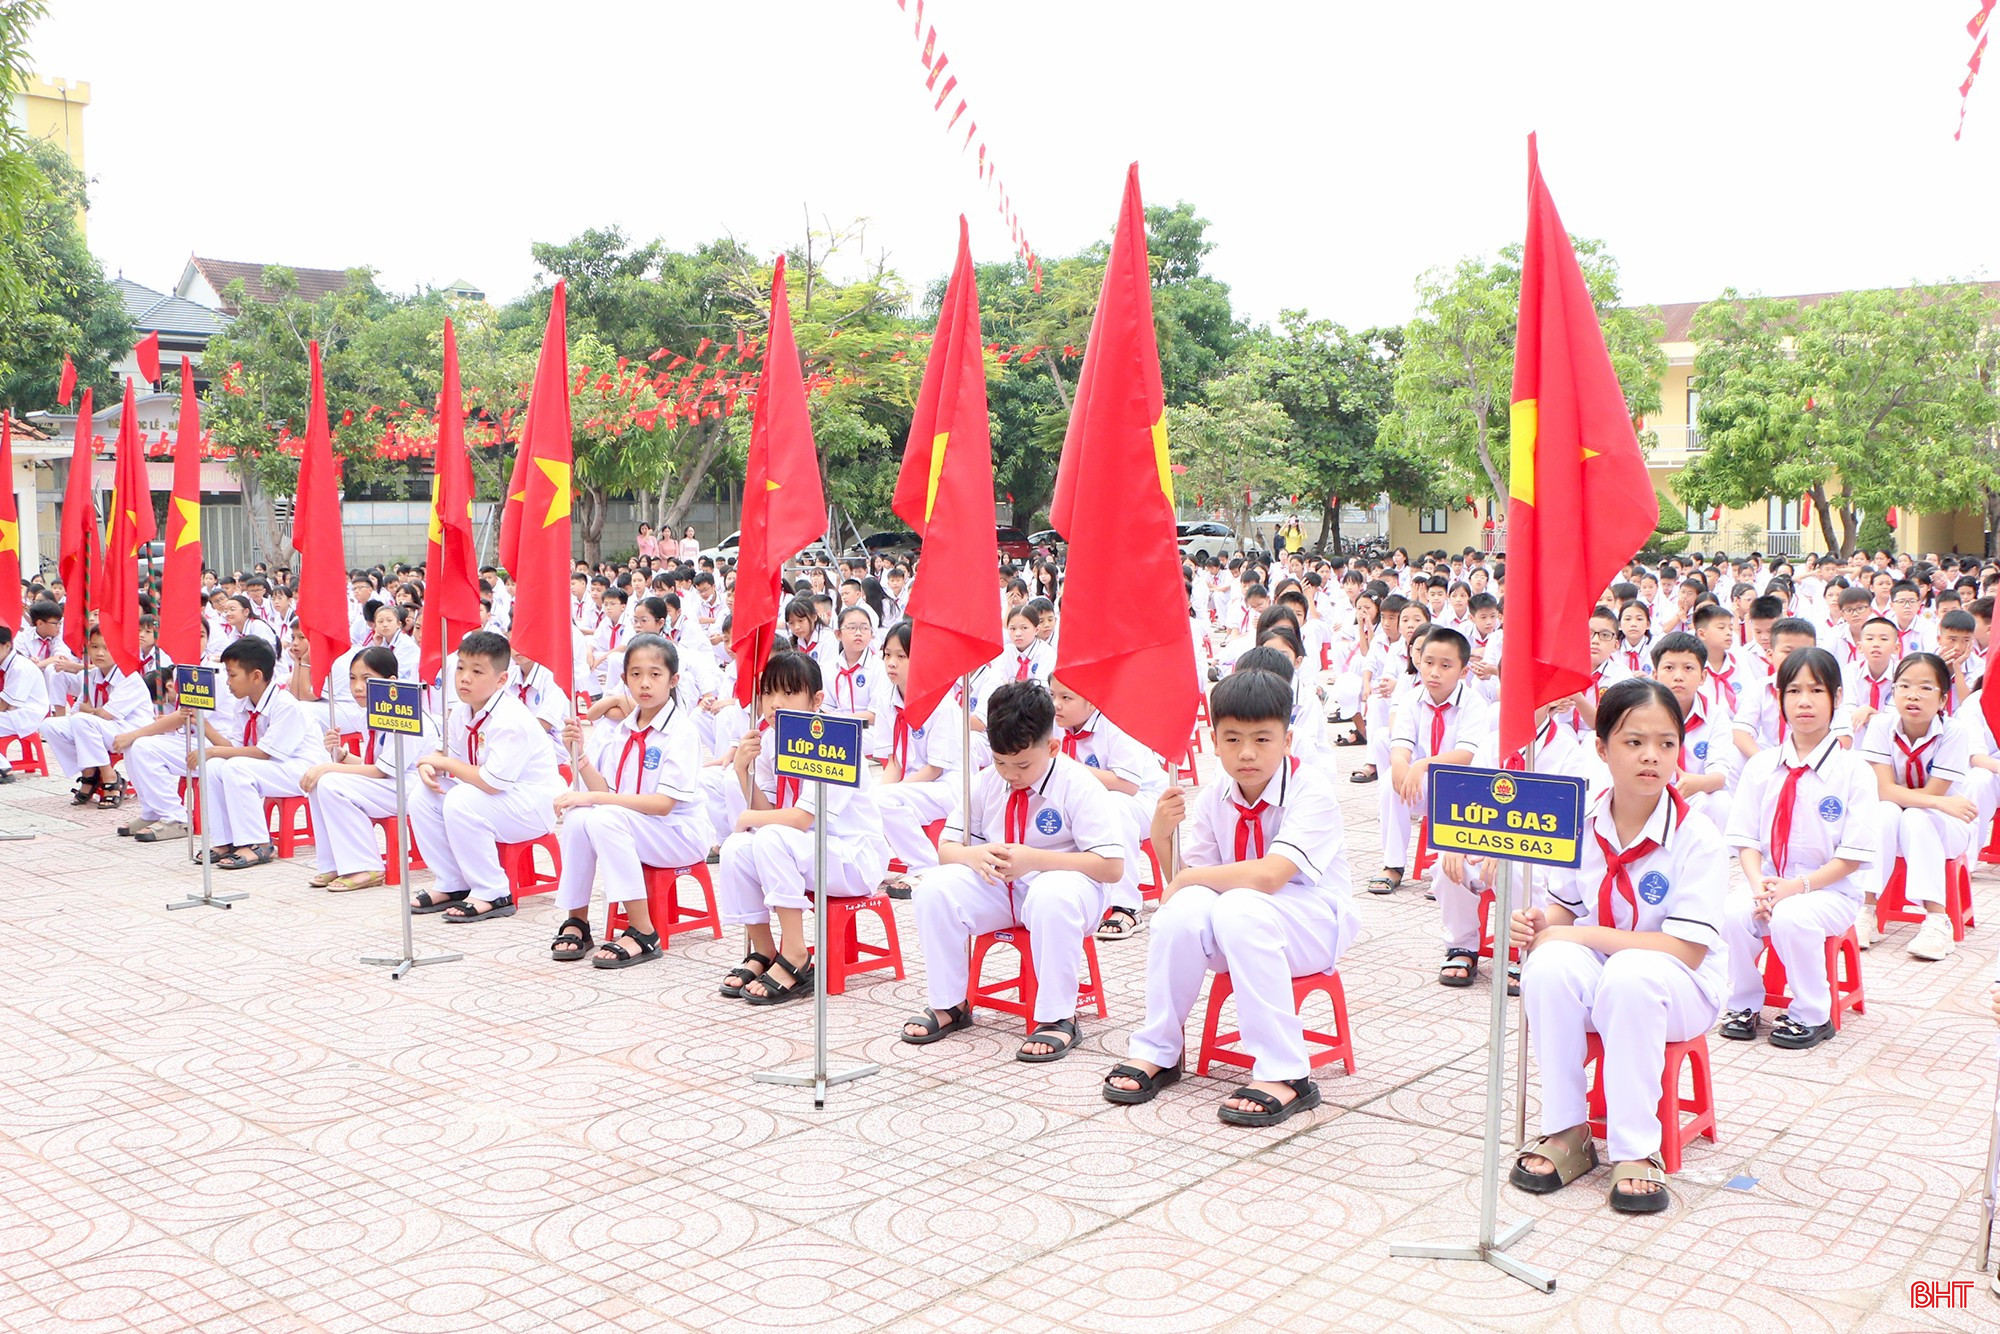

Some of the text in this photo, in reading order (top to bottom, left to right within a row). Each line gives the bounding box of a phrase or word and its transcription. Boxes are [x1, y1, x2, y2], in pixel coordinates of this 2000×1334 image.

[183, 682, 209, 695] LỚP 6A6
[185, 696, 199, 705] CLASS
[375, 700, 413, 717] LỚP 6A5
[378, 717, 413, 729] CLASS 6A5
[787, 738, 847, 761] LỚP 6A4
[790, 760, 844, 777] CLASS 6A4
[1451, 802, 1558, 832] LỚP 6A3
[1455, 831, 1553, 855] CLASS 6A3
